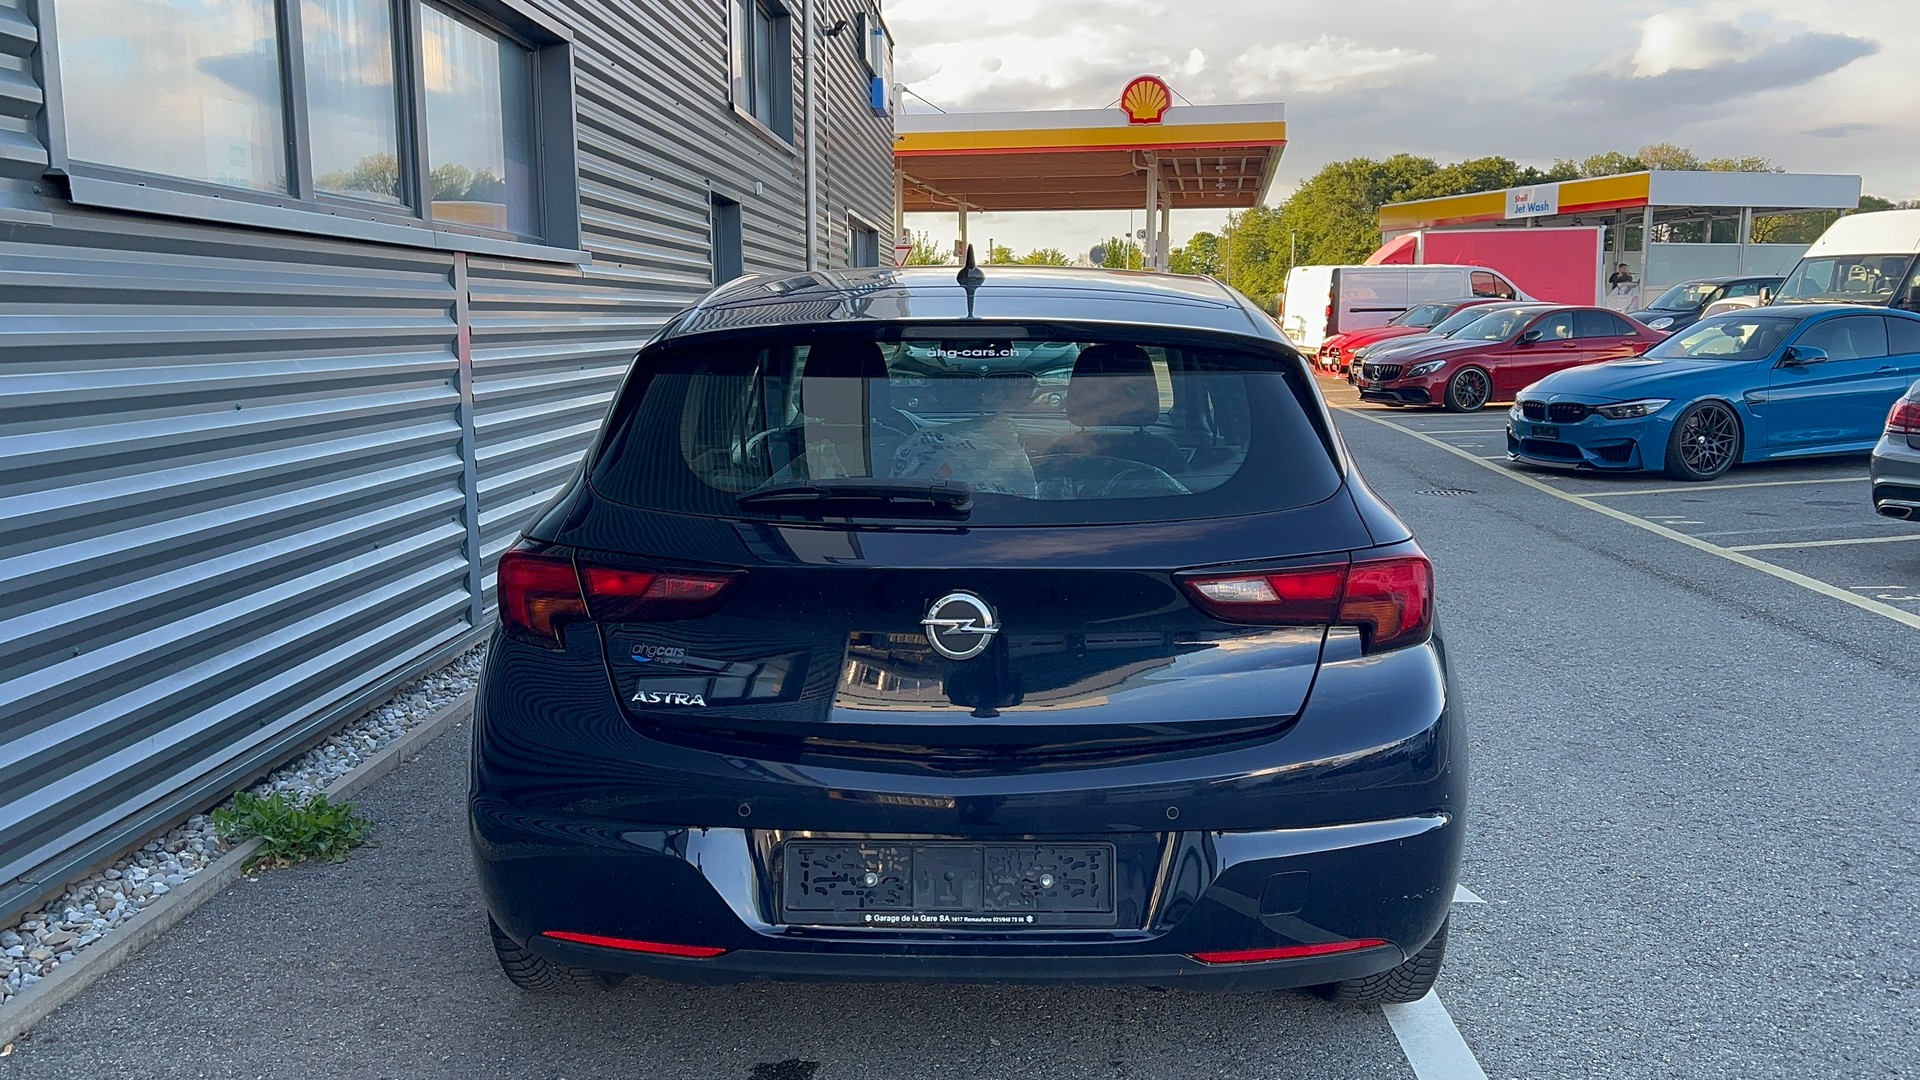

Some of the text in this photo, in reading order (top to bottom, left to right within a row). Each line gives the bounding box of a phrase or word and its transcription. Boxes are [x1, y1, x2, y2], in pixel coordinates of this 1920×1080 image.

[1514, 194, 1529, 203] Shell
[1514, 200, 1550, 214] Jet Wash
[926, 348, 1020, 359] ahg-cars.ch
[631, 690, 707, 707] ASTRA
[873, 914, 900, 923] Garage
[901, 914, 911, 922] de
[912, 914, 919, 922] la
[920, 914, 938, 922] Gare
[939, 914, 950, 922] SA
